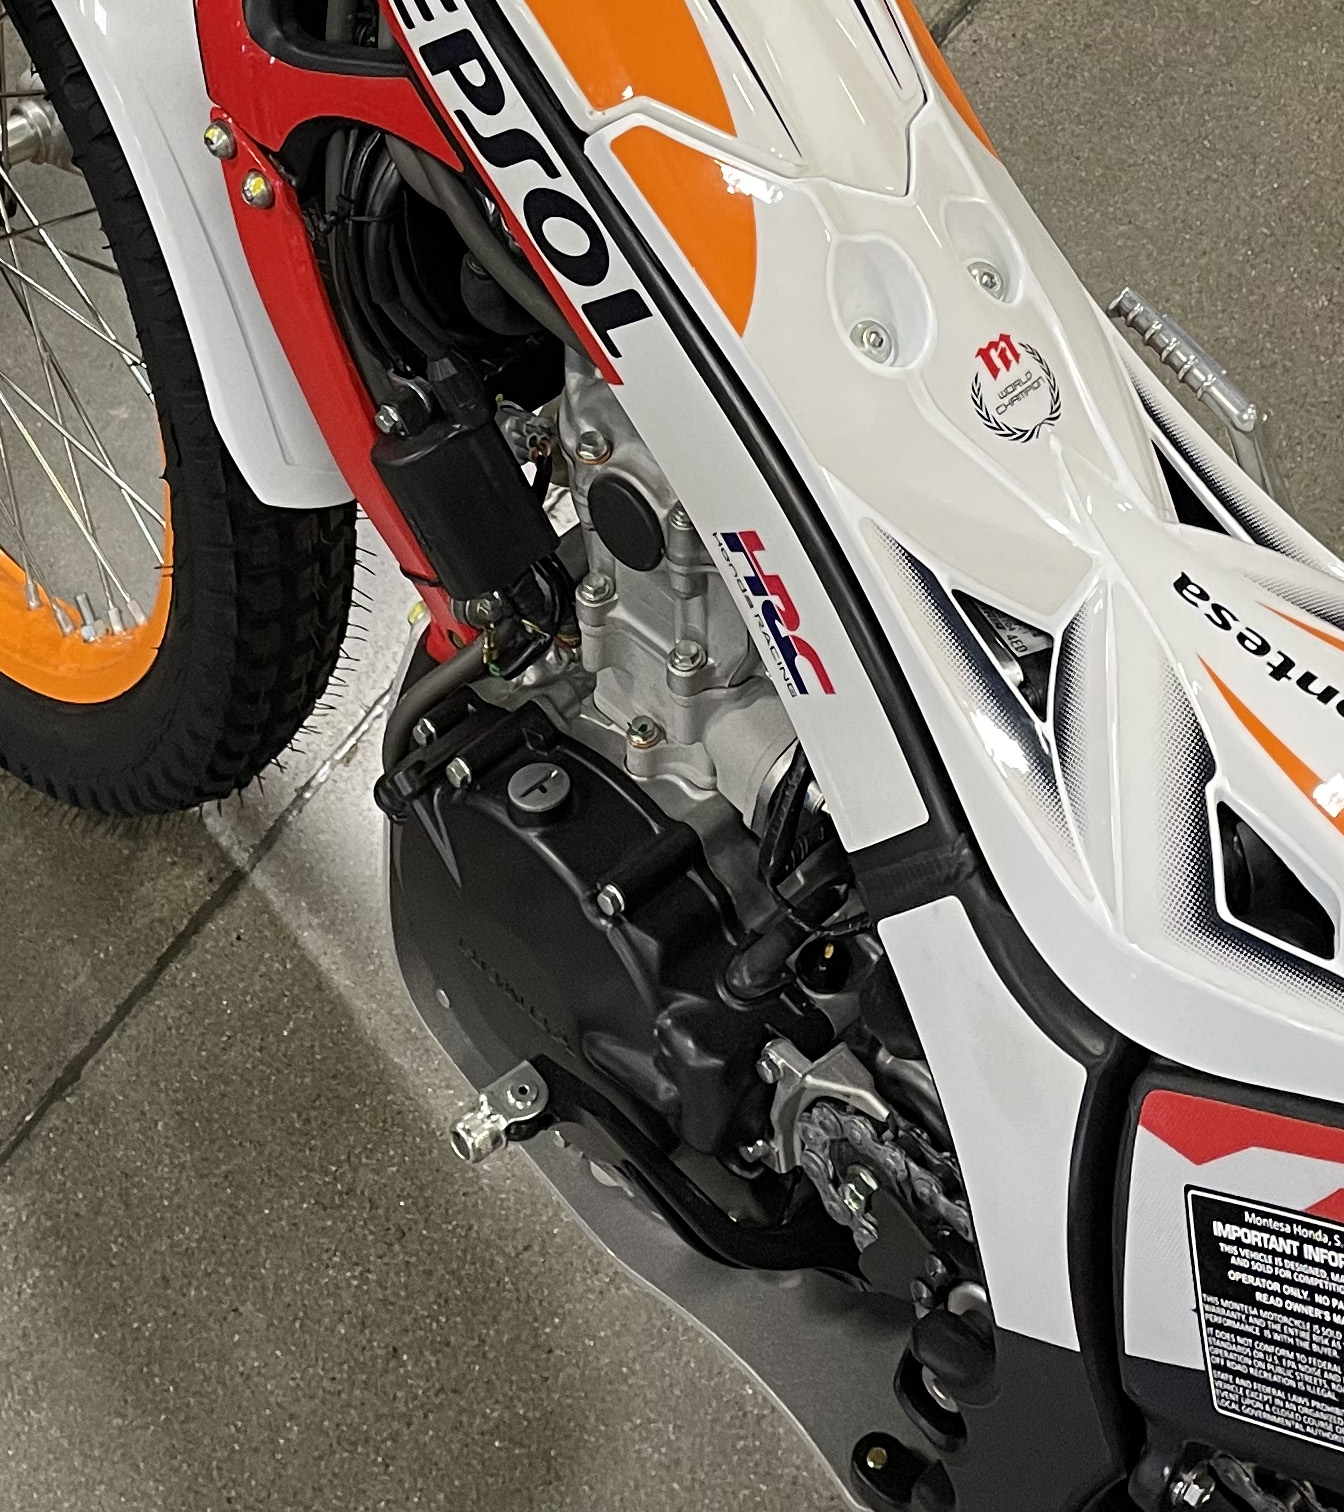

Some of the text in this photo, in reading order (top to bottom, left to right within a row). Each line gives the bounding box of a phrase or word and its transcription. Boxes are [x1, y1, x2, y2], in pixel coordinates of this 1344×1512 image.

[995, 376, 1046, 416] CHAMPION
[997, 370, 1033, 400] WORLD
[721, 530, 837, 695] HRC
[754, 613, 798, 698] RACING
[1211, 1219, 1301, 1258] IMPORTANT
[1243, 1210, 1291, 1234] Montesa
[1292, 1222, 1332, 1247] Honda,
[1333, 1233, 1344, 1248] S.
[1218, 1241, 1238, 1256] THIS
[1238, 1247, 1273, 1265] VEHICLE
[1274, 1256, 1283, 1268] IS
[1230, 1254, 1250, 1269] AND
[1250, 1260, 1273, 1275] SOLD
[1274, 1267, 1291, 1280] FOR
[1227, 1268, 1281, 1293] OPERATOR
[1282, 1283, 1310, 1301] ONLY.
[1314, 1292, 1330, 1307] NO
[1255, 1290, 1283, 1308] READ
[1284, 1298, 1331, 1322] OWNER'S
[1321, 1325, 1342, 1340] SOLD
[1295, 1352, 1307, 1364] TO
